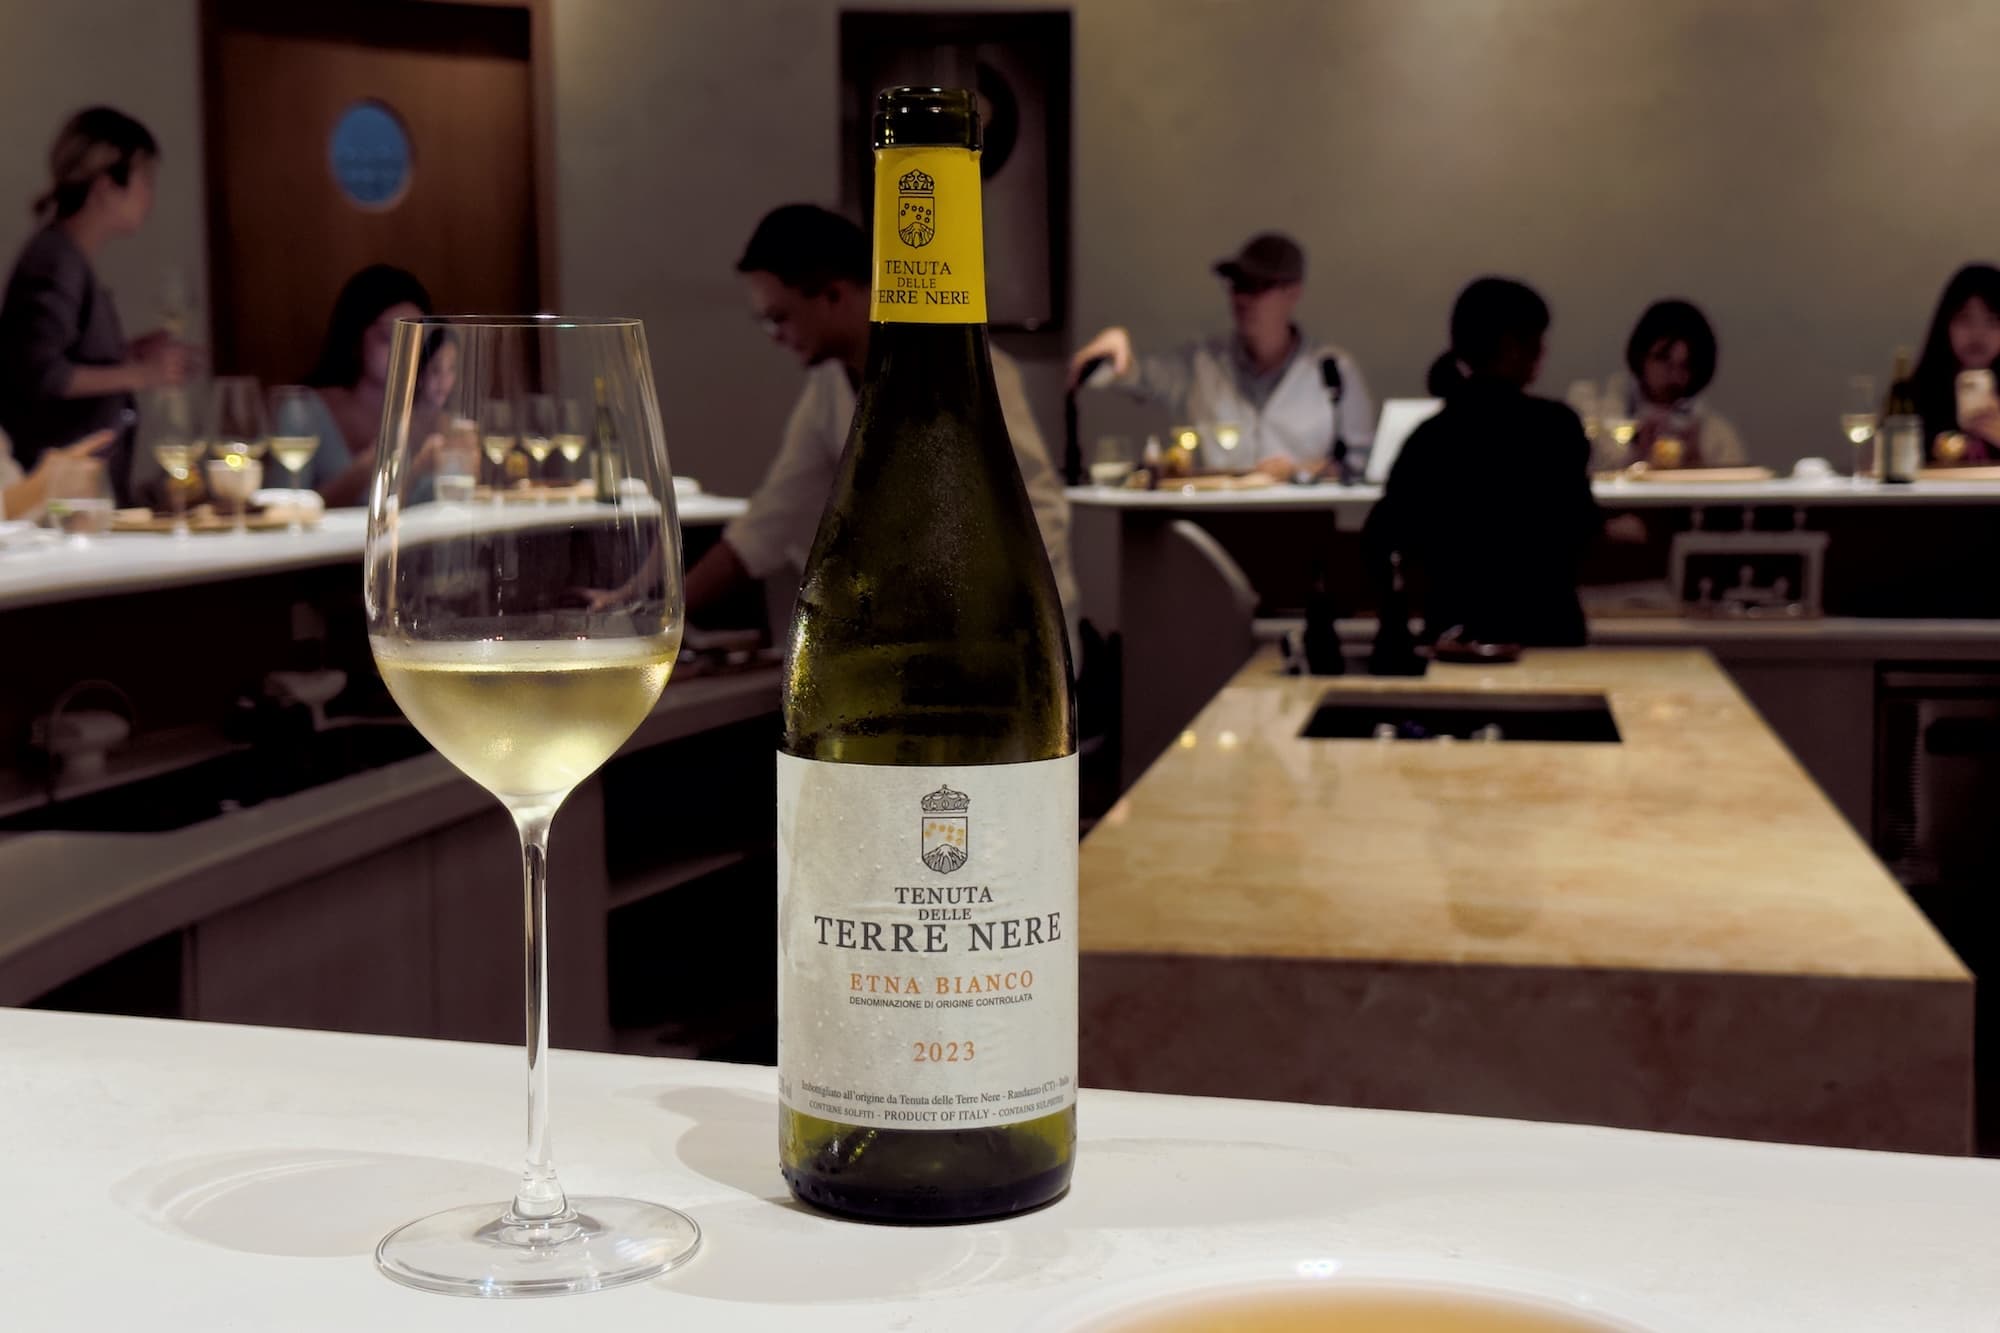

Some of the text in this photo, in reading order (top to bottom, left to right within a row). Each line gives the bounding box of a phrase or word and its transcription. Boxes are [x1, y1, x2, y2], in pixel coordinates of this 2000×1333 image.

[885, 260, 952, 275] TENUTA
[897, 277, 937, 288] DELLE
[875, 290, 970, 304] ERRE NERE
[895, 886, 993, 904] TENUTA
[918, 908, 972, 921] DELLE
[814, 911, 1061, 952] TERRE NERE
[850, 970, 1033, 994] ETNA BIANCO
[849, 993, 1033, 1009] DENOMINAZIONE DI ORIGINE CONTROLLATA
[913, 1040, 976, 1062] 2023
[887, 1094, 897, 1104] da
[900, 1094, 930, 1105] Tenuta
[931, 1094, 953, 1105] delle
[955, 1094, 978, 1105] Terre
[980, 1092, 1001, 1103] Nere
[884, 1109, 937, 1122] PRODUCT
[940, 1111, 956, 1122] OF
[958, 1108, 989, 1121] ITALY
[998, 1103, 1035, 1117] CONTAINS
